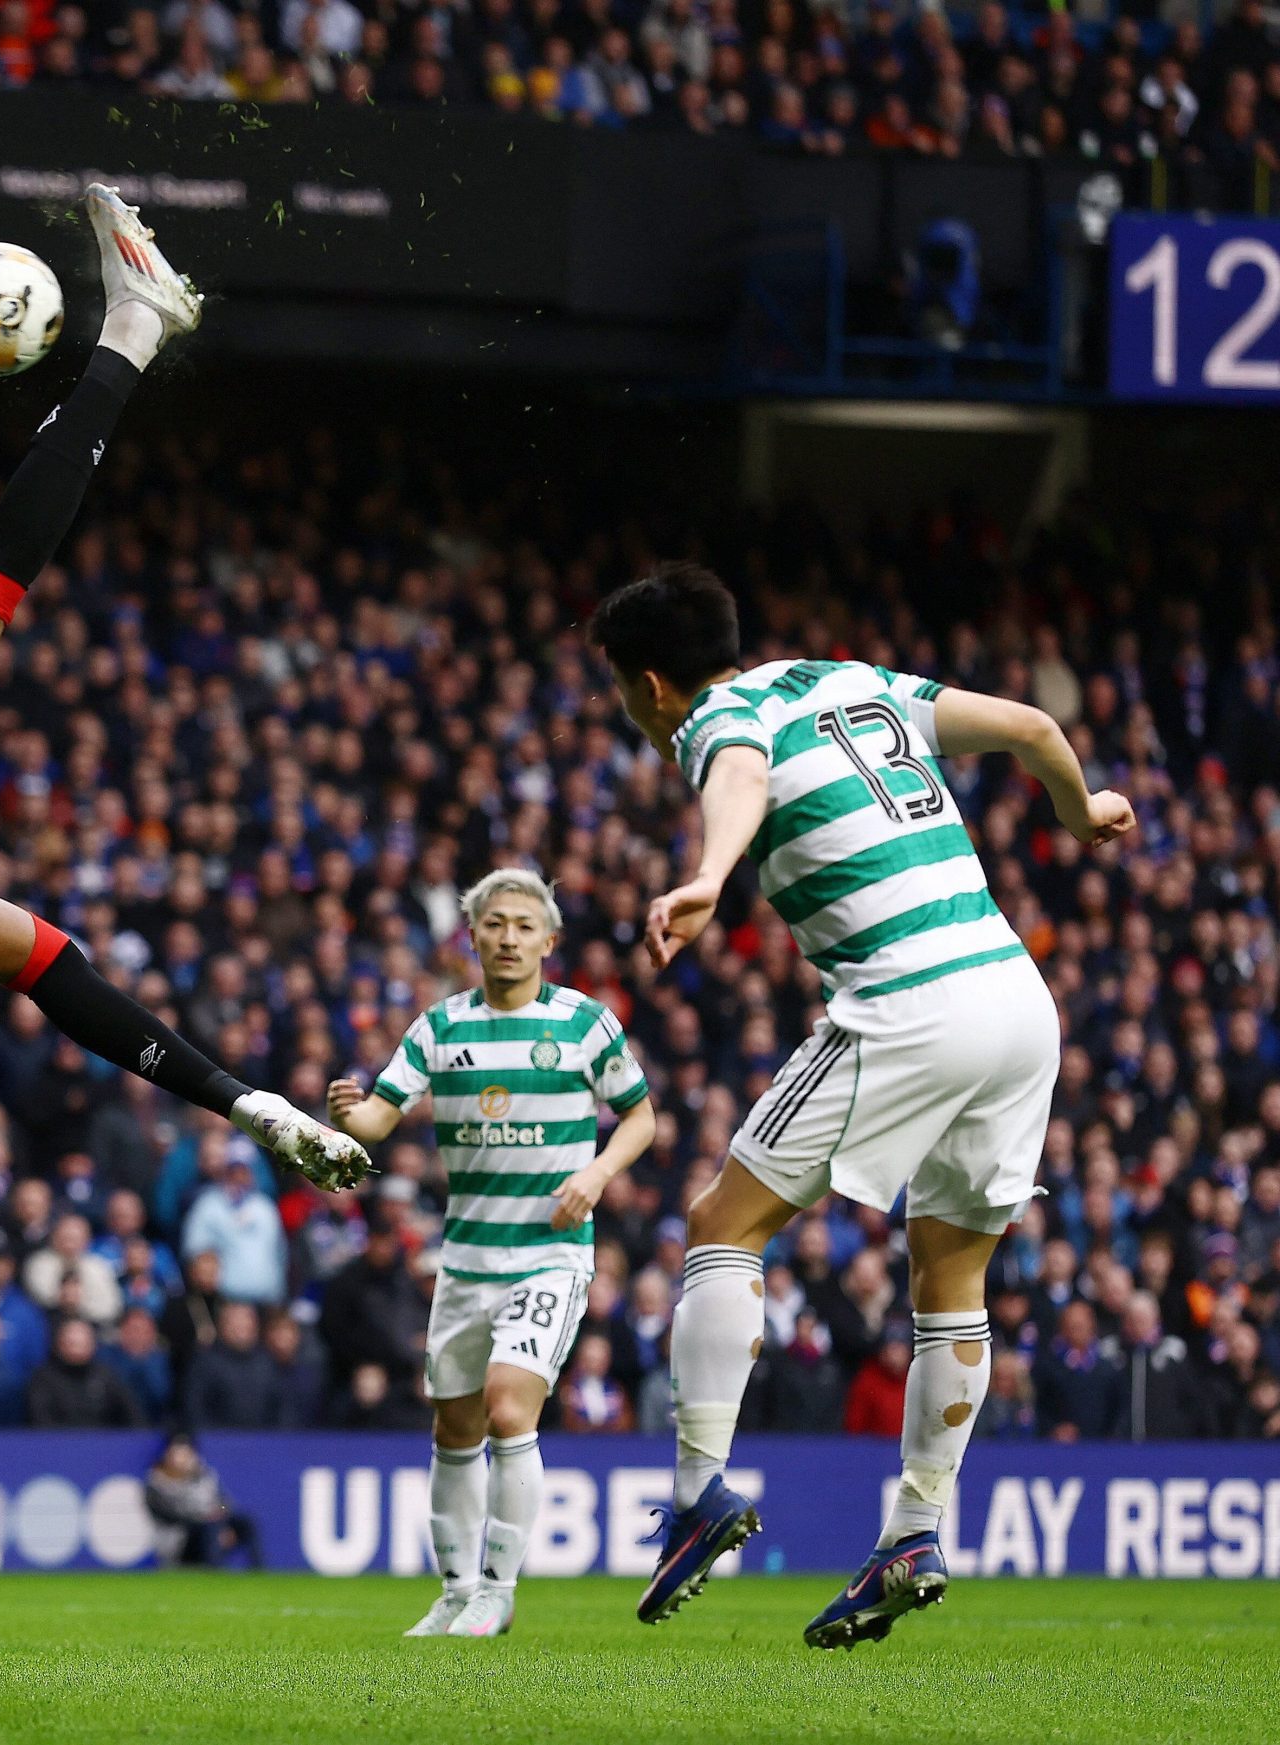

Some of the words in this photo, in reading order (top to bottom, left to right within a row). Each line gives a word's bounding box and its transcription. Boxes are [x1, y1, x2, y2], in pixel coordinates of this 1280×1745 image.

[817, 700, 945, 824] 13
[455, 1120, 546, 1150] dafabet
[506, 1288, 558, 1328] 38
